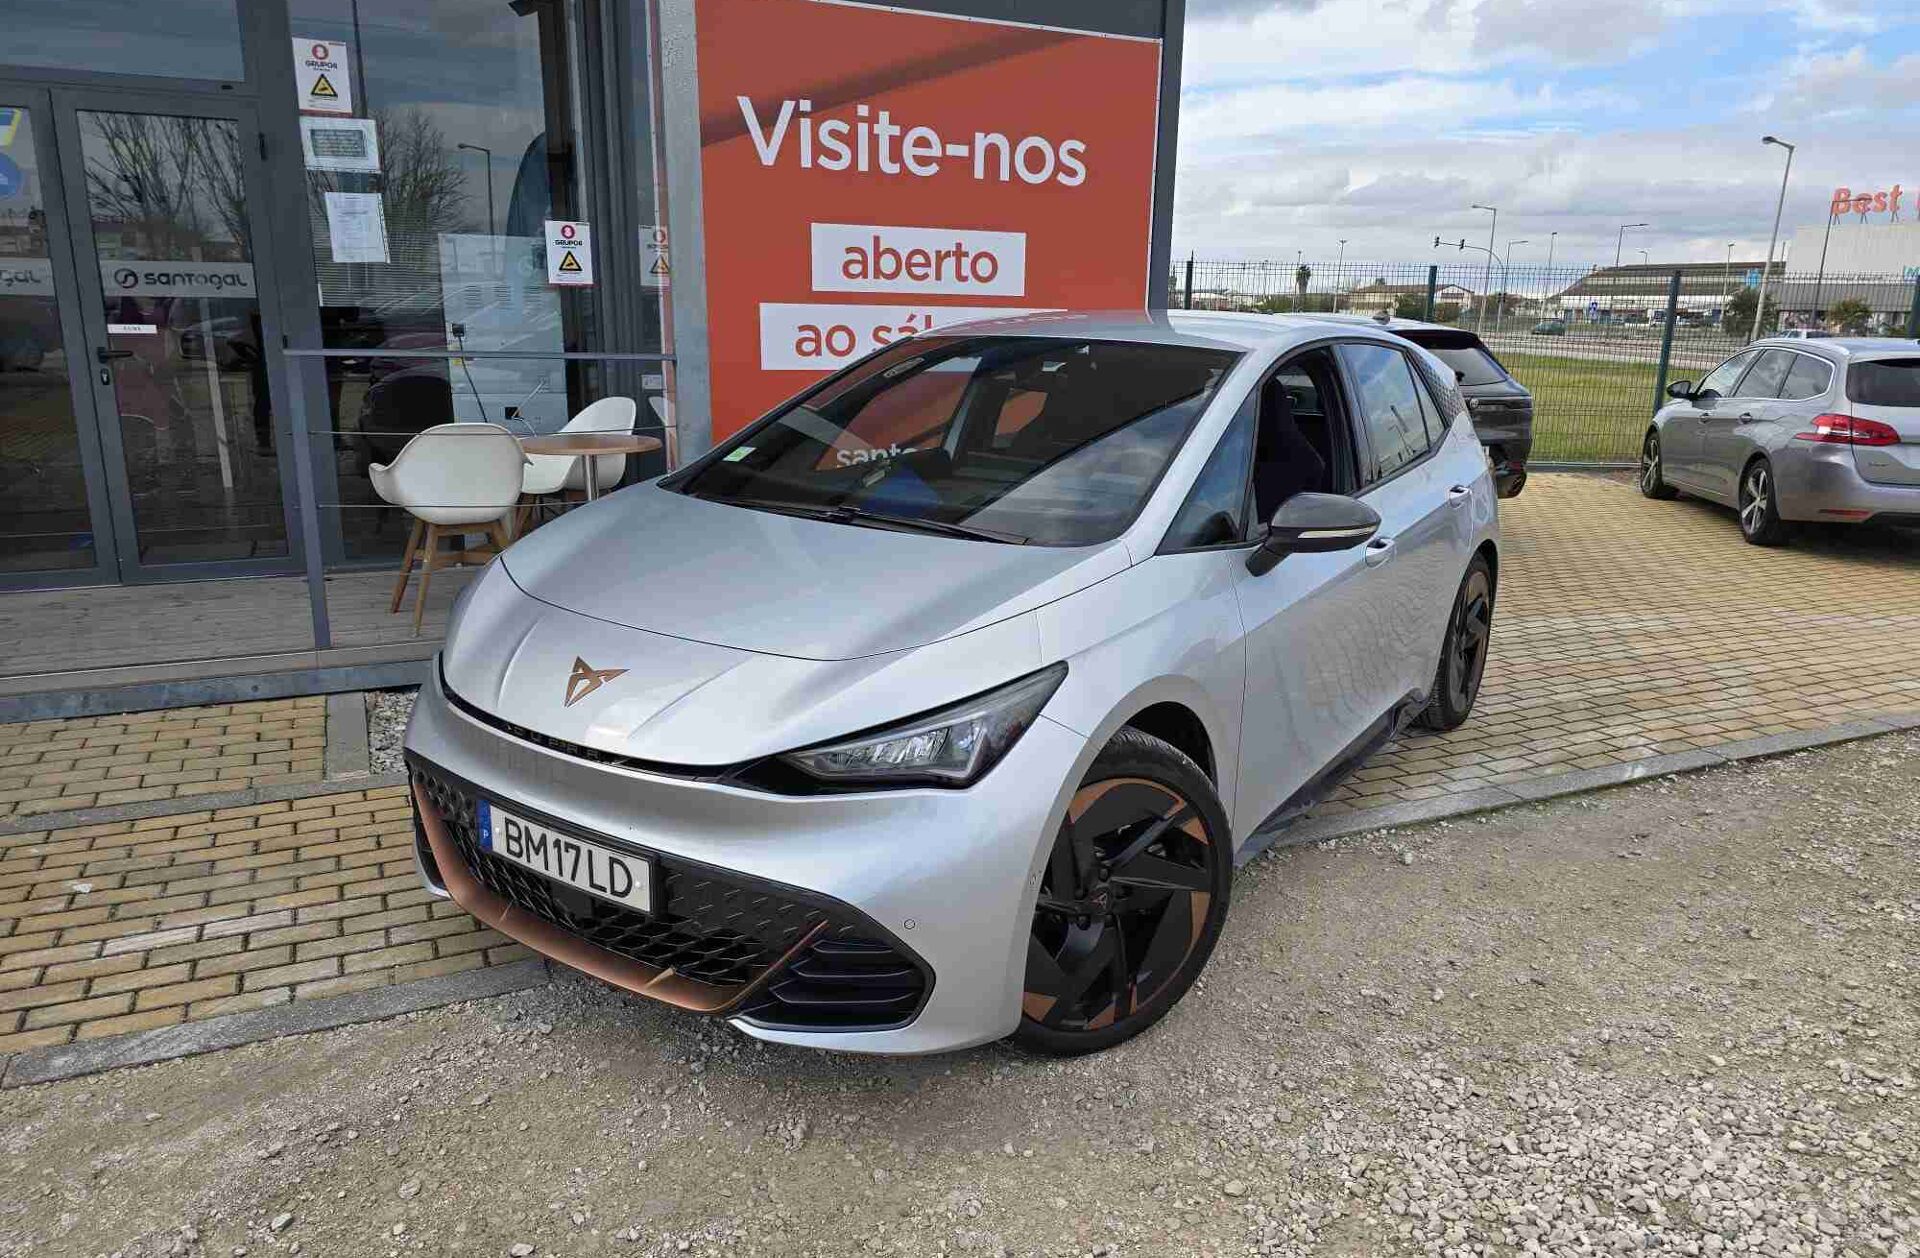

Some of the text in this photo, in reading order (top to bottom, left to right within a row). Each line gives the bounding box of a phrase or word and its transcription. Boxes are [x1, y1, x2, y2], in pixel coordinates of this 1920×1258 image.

[737, 96, 1087, 186] Visite-nos
[1832, 184, 1903, 214] Best
[842, 235, 998, 283] aberto
[144, 272, 248, 290] santogal
[795, 324, 857, 357] ao
[504, 816, 633, 898] BM17LD
